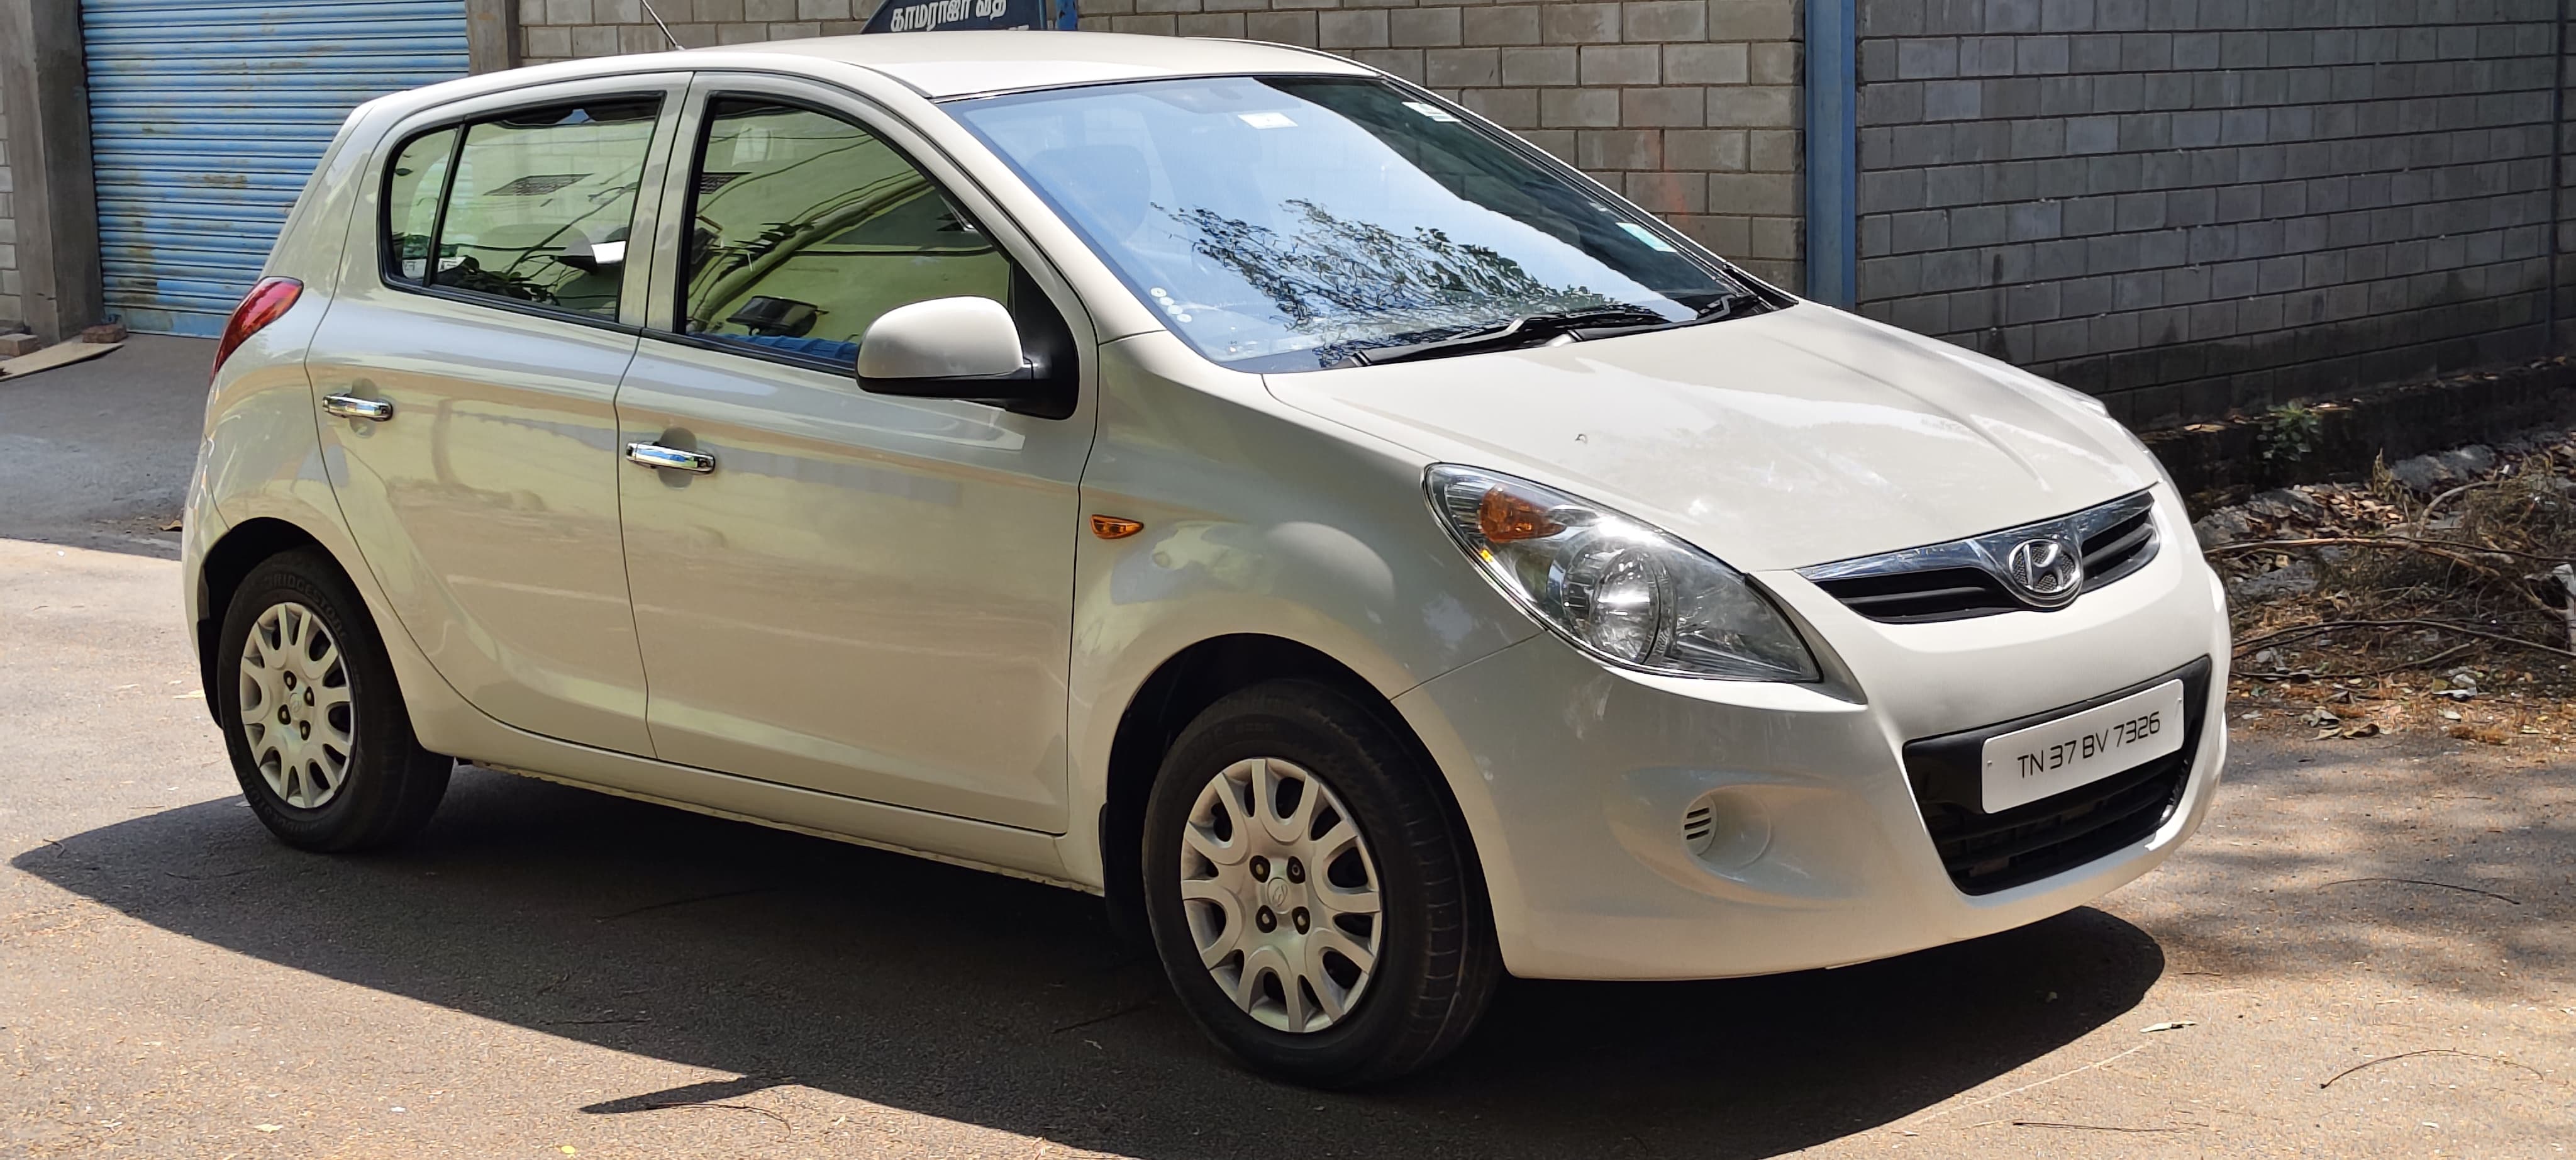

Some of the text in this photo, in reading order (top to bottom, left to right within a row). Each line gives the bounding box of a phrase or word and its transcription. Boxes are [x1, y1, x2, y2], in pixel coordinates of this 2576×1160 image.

[2017, 710, 2160, 778] TN 37 BV 7326
